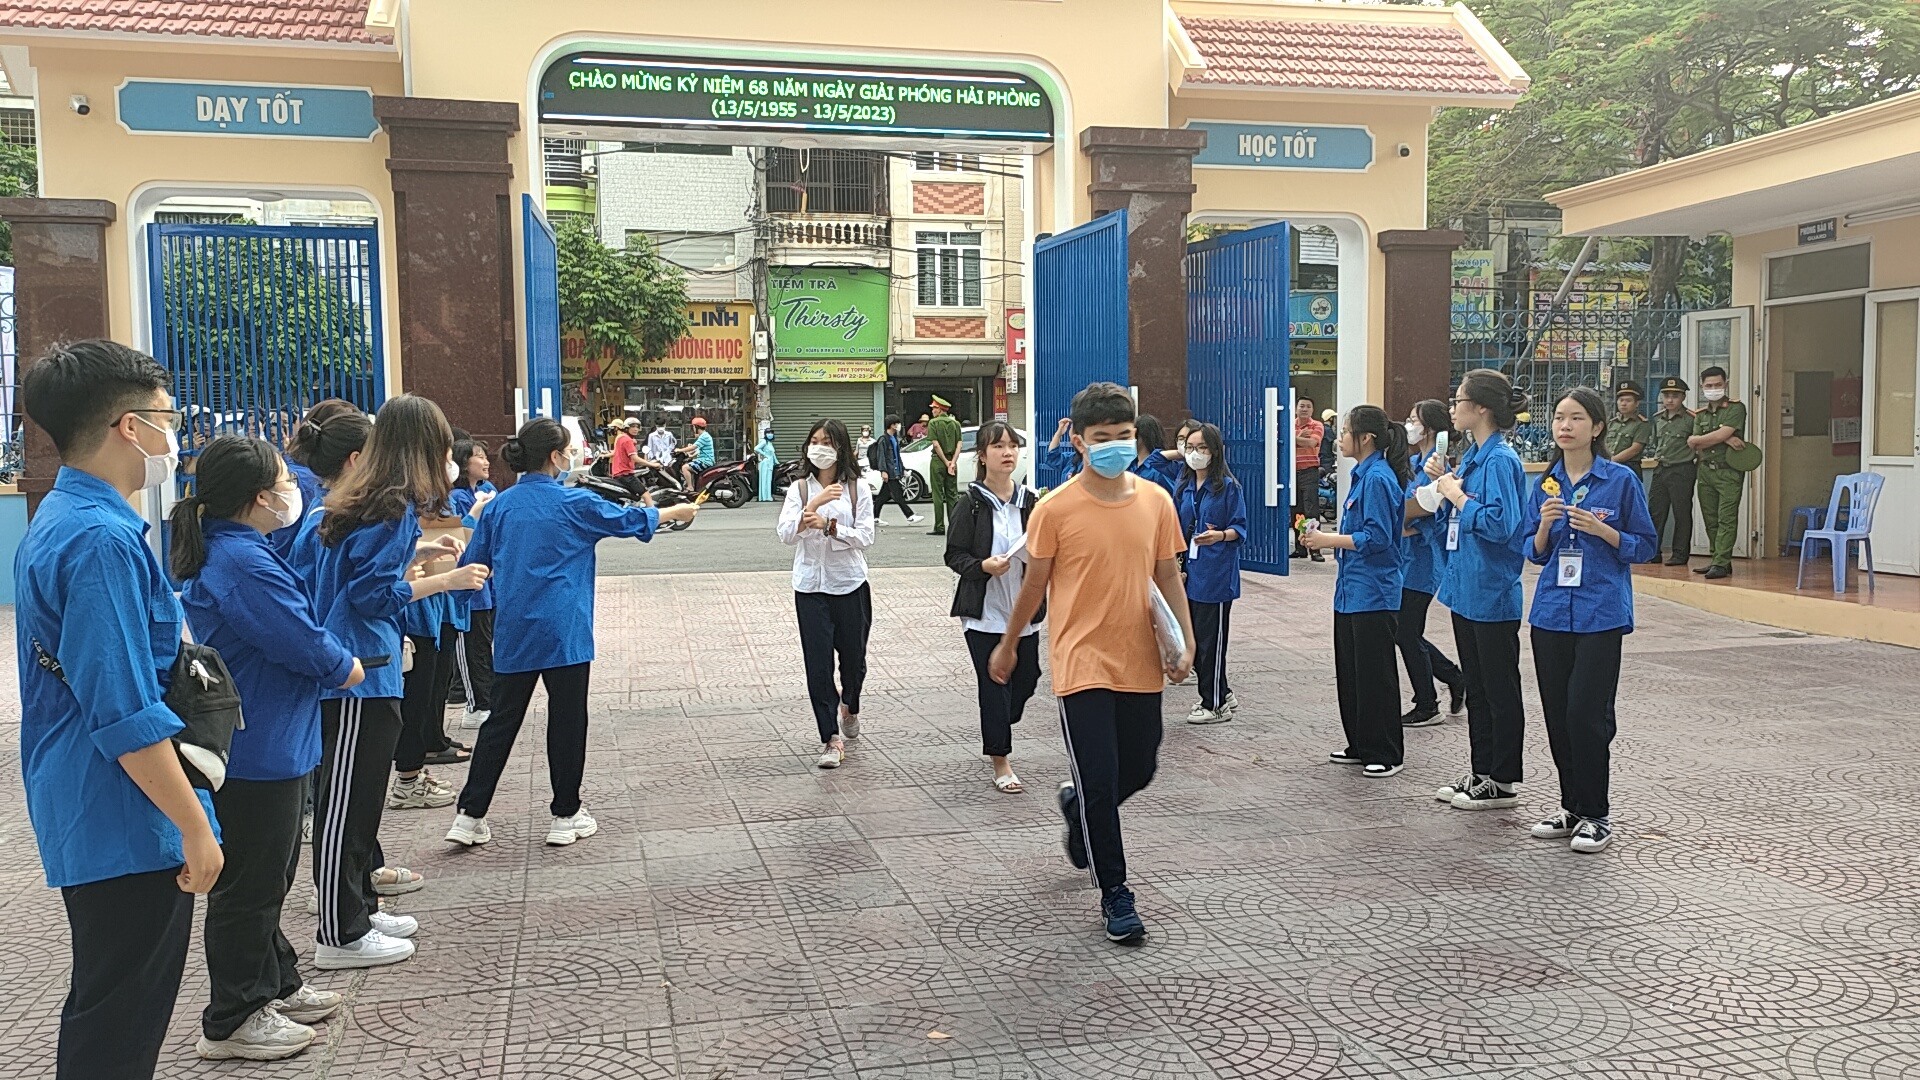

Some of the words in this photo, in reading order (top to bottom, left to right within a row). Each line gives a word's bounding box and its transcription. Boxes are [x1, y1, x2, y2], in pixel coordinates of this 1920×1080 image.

[569, 69, 617, 89] CHÀO
[621, 71, 672, 91] MỪNG
[677, 73, 699, 92] KỶ
[703, 75, 744, 97] NIỆM
[748, 80, 769, 95] 68
[773, 78, 808, 97] NĂM
[812, 80, 855, 99] NGÀY
[859, 82, 894, 101] GIẢI
[898, 84, 952, 103] PHÓNG
[957, 86, 984, 105] HẢI
[987, 88, 1041, 107] PHÒNG
[196, 95, 249, 129] DẠY
[256, 90, 304, 125] TỐT
[711, 98, 798, 118] (13/5/1955
[813, 103, 896, 124] 13/5/2023)
[1239, 134, 1277, 162] HỌC
[1282, 128, 1317, 158] TỐT
[771, 277, 803, 292] TIỆM
[809, 278, 837, 290] TRÀ
[781, 296, 868, 340] Thirsty
[715, 338, 742, 362] HỌC
